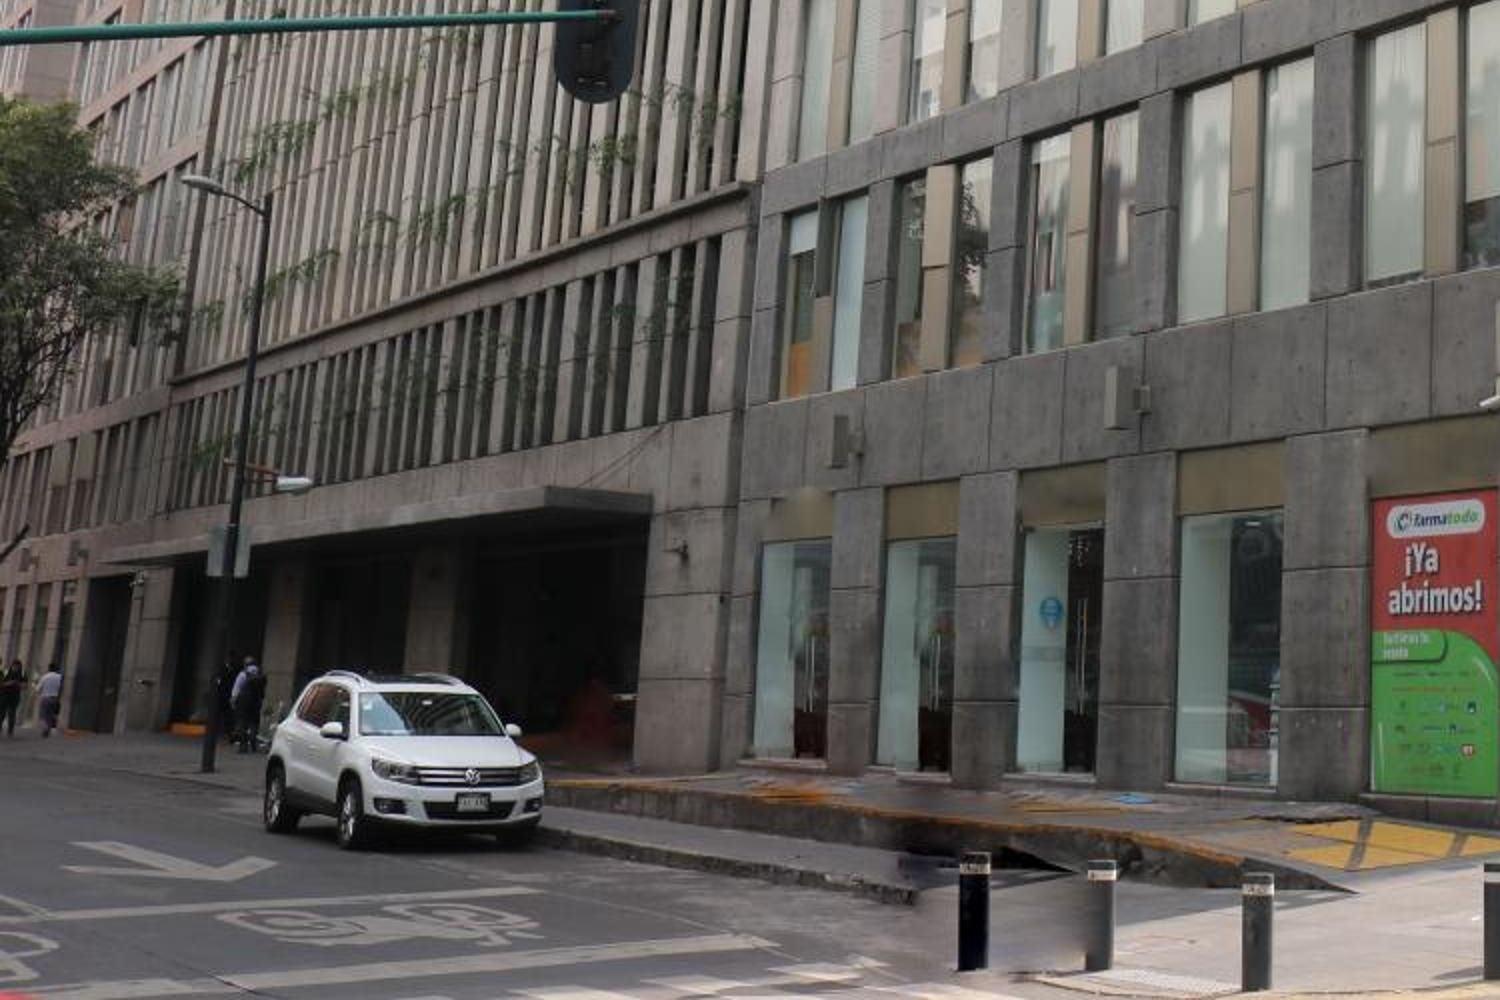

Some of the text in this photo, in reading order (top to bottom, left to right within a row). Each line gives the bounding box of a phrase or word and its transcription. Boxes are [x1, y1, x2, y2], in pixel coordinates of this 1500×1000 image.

[1414, 508, 1479, 528] farmatodo
[1405, 542, 1439, 577] ¡Ya
[1388, 579, 1482, 614] abrimos!
